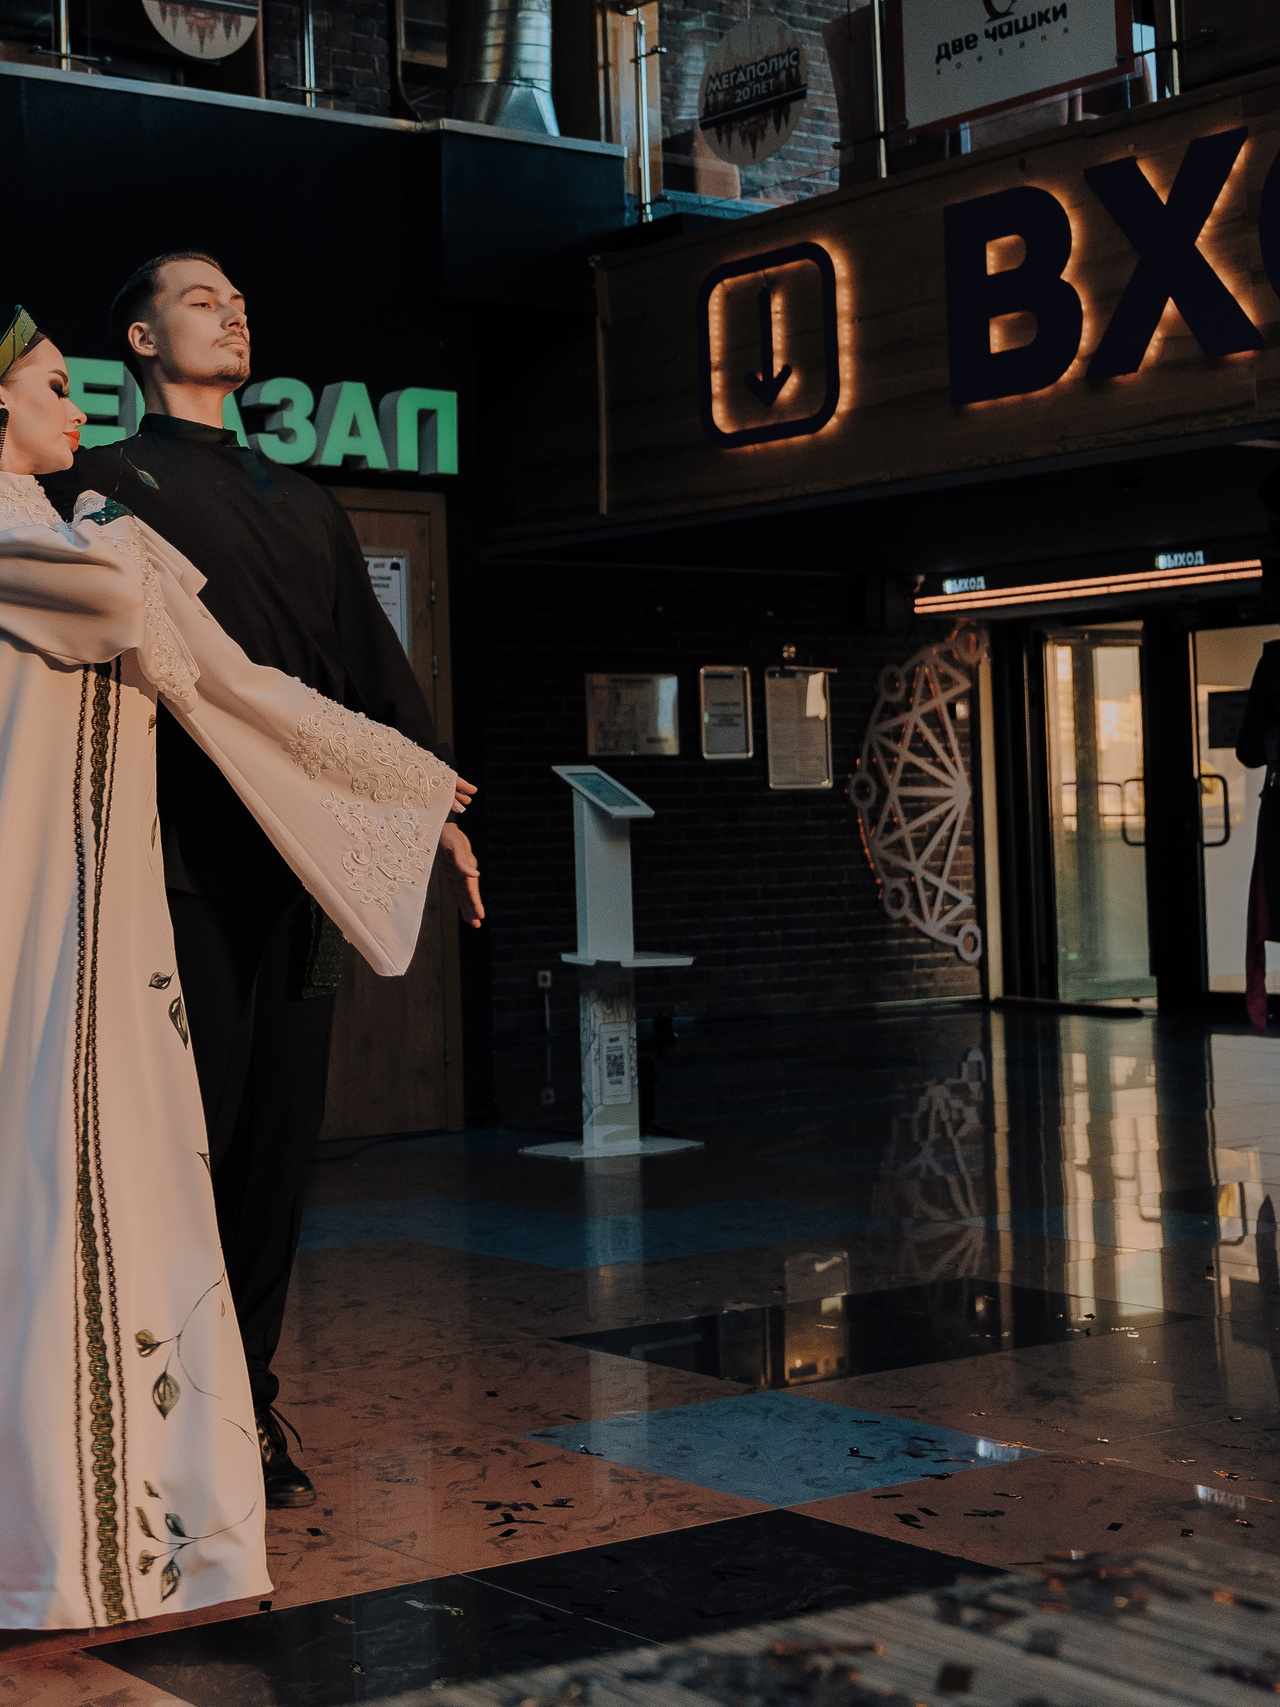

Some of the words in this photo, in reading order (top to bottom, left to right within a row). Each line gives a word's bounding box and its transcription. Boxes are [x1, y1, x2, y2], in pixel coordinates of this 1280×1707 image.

[706, 49, 800, 95] МЕГАПОЛИС
[734, 88, 749, 103] 20
[751, 78, 776, 97] ЛЕТ
[943, 126, 1280, 408] ВХ
